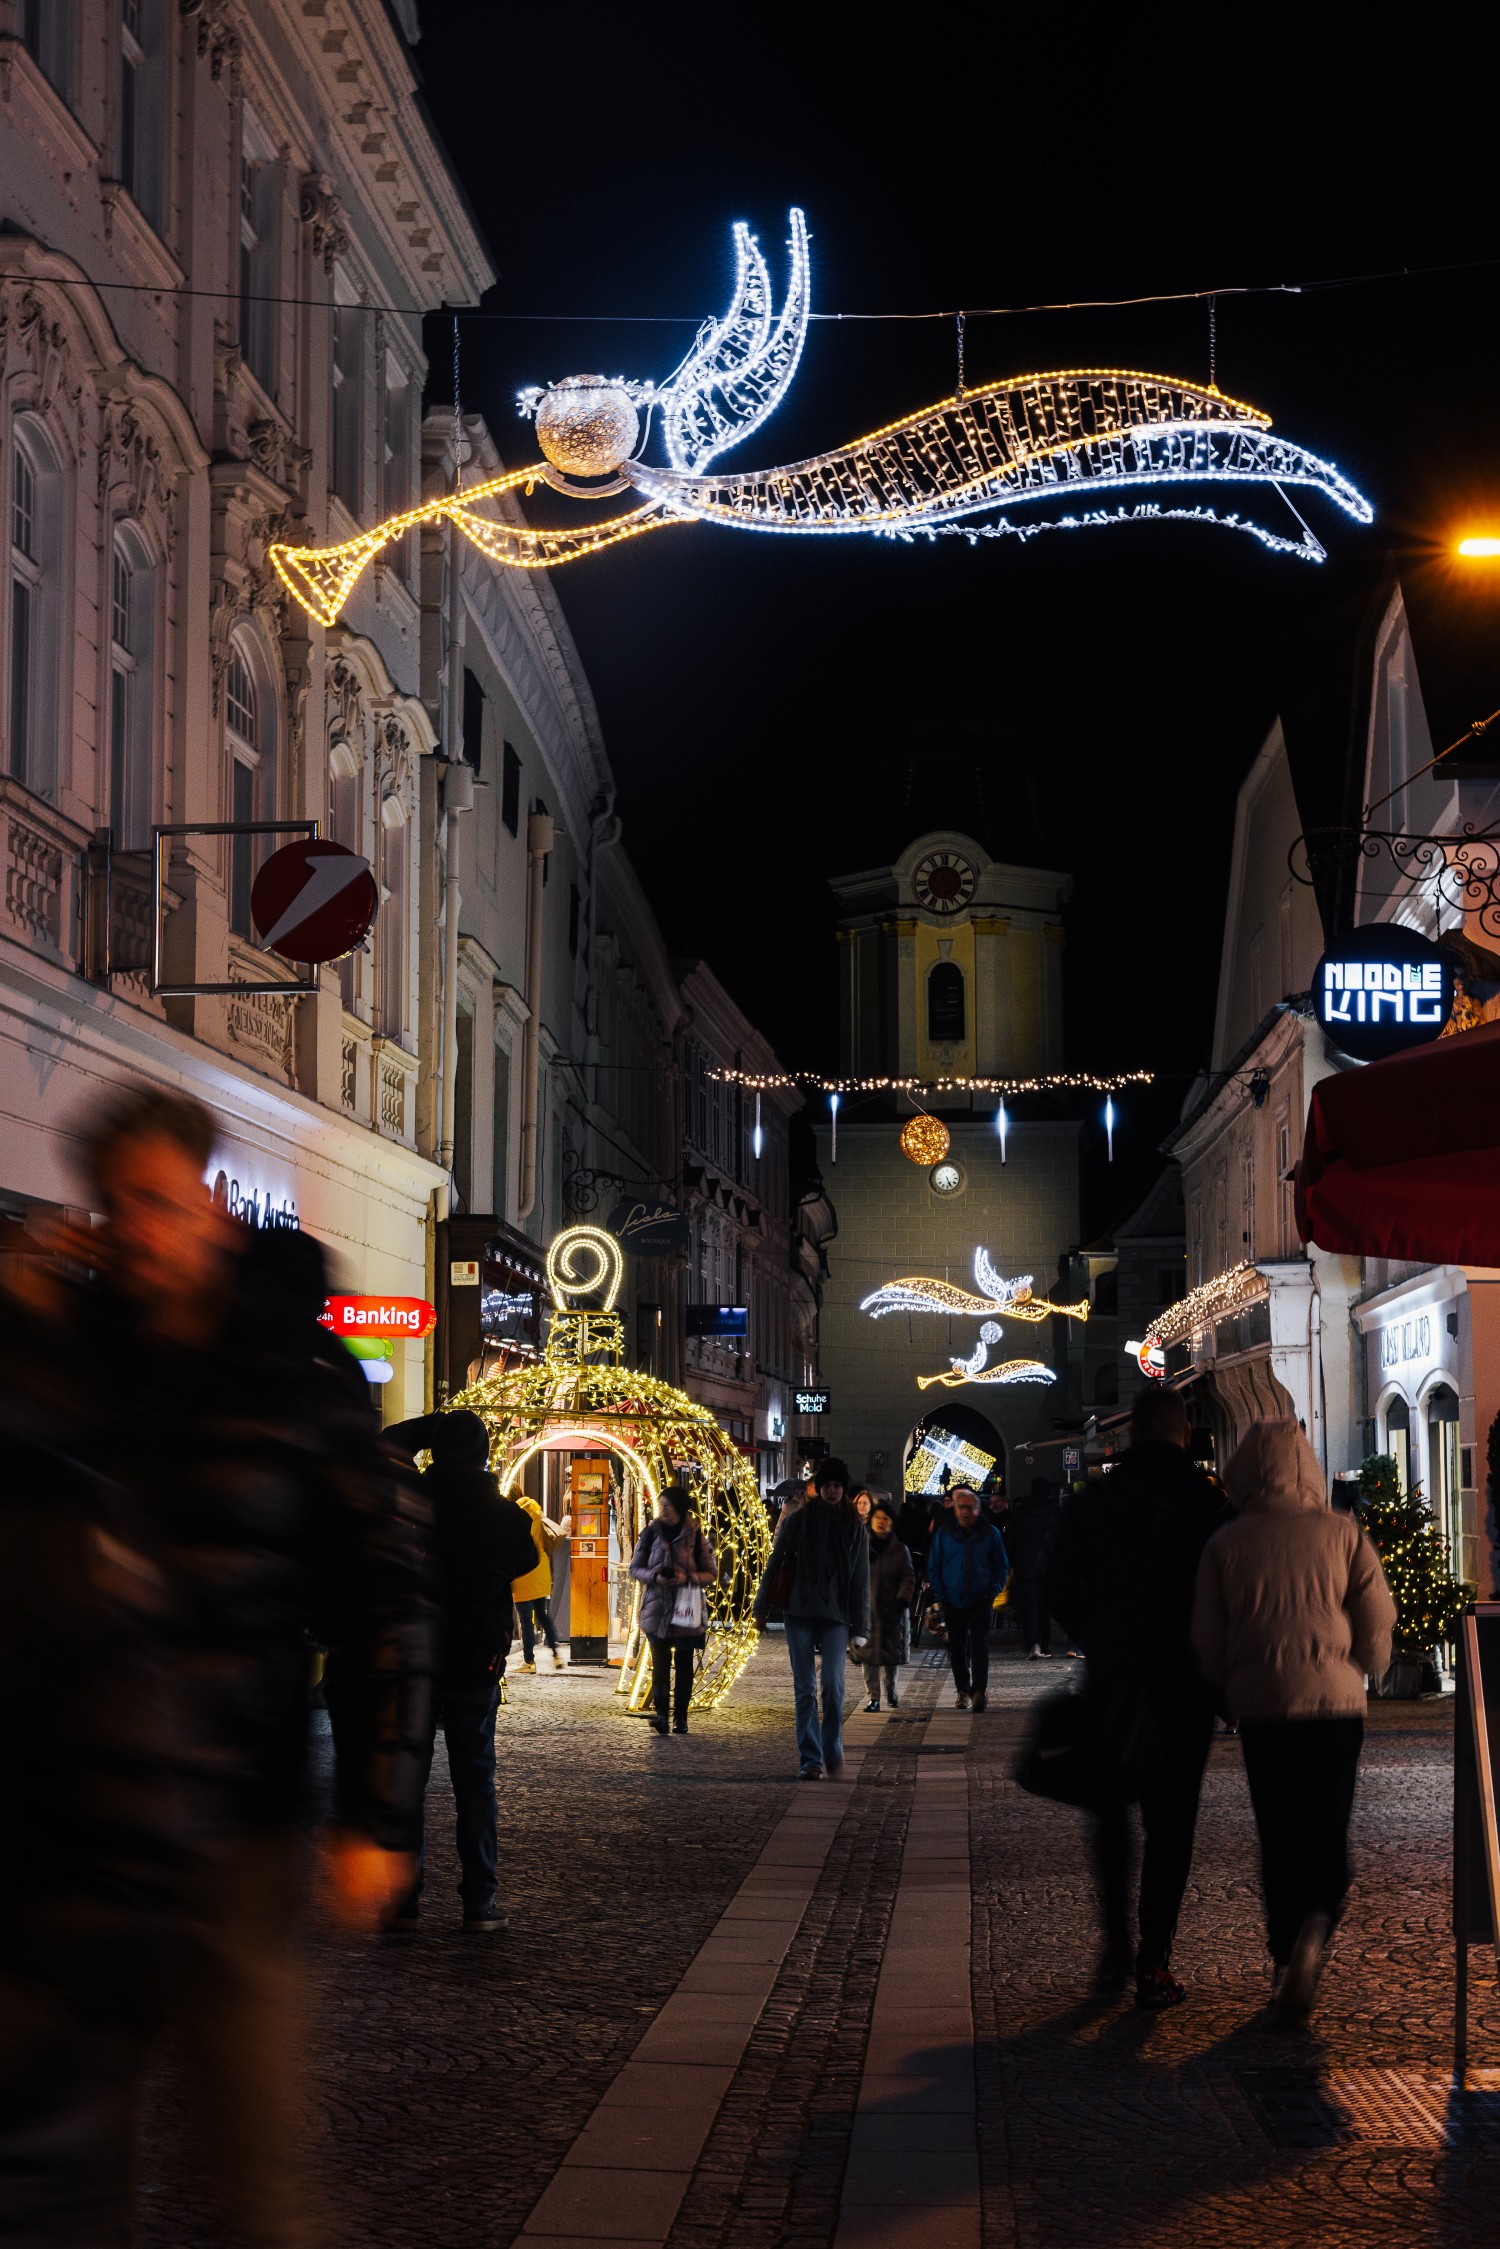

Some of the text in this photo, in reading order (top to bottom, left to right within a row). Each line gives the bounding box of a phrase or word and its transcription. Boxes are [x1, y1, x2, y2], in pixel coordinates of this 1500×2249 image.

[1325, 962, 1442, 990] NOODLE
[1325, 990, 1442, 1022] KING
[615, 1203, 681, 1237] Scala
[343, 1306, 420, 1330] Banking
[796, 1393, 827, 1403] Schuhe
[800, 1403, 823, 1413] Mold
